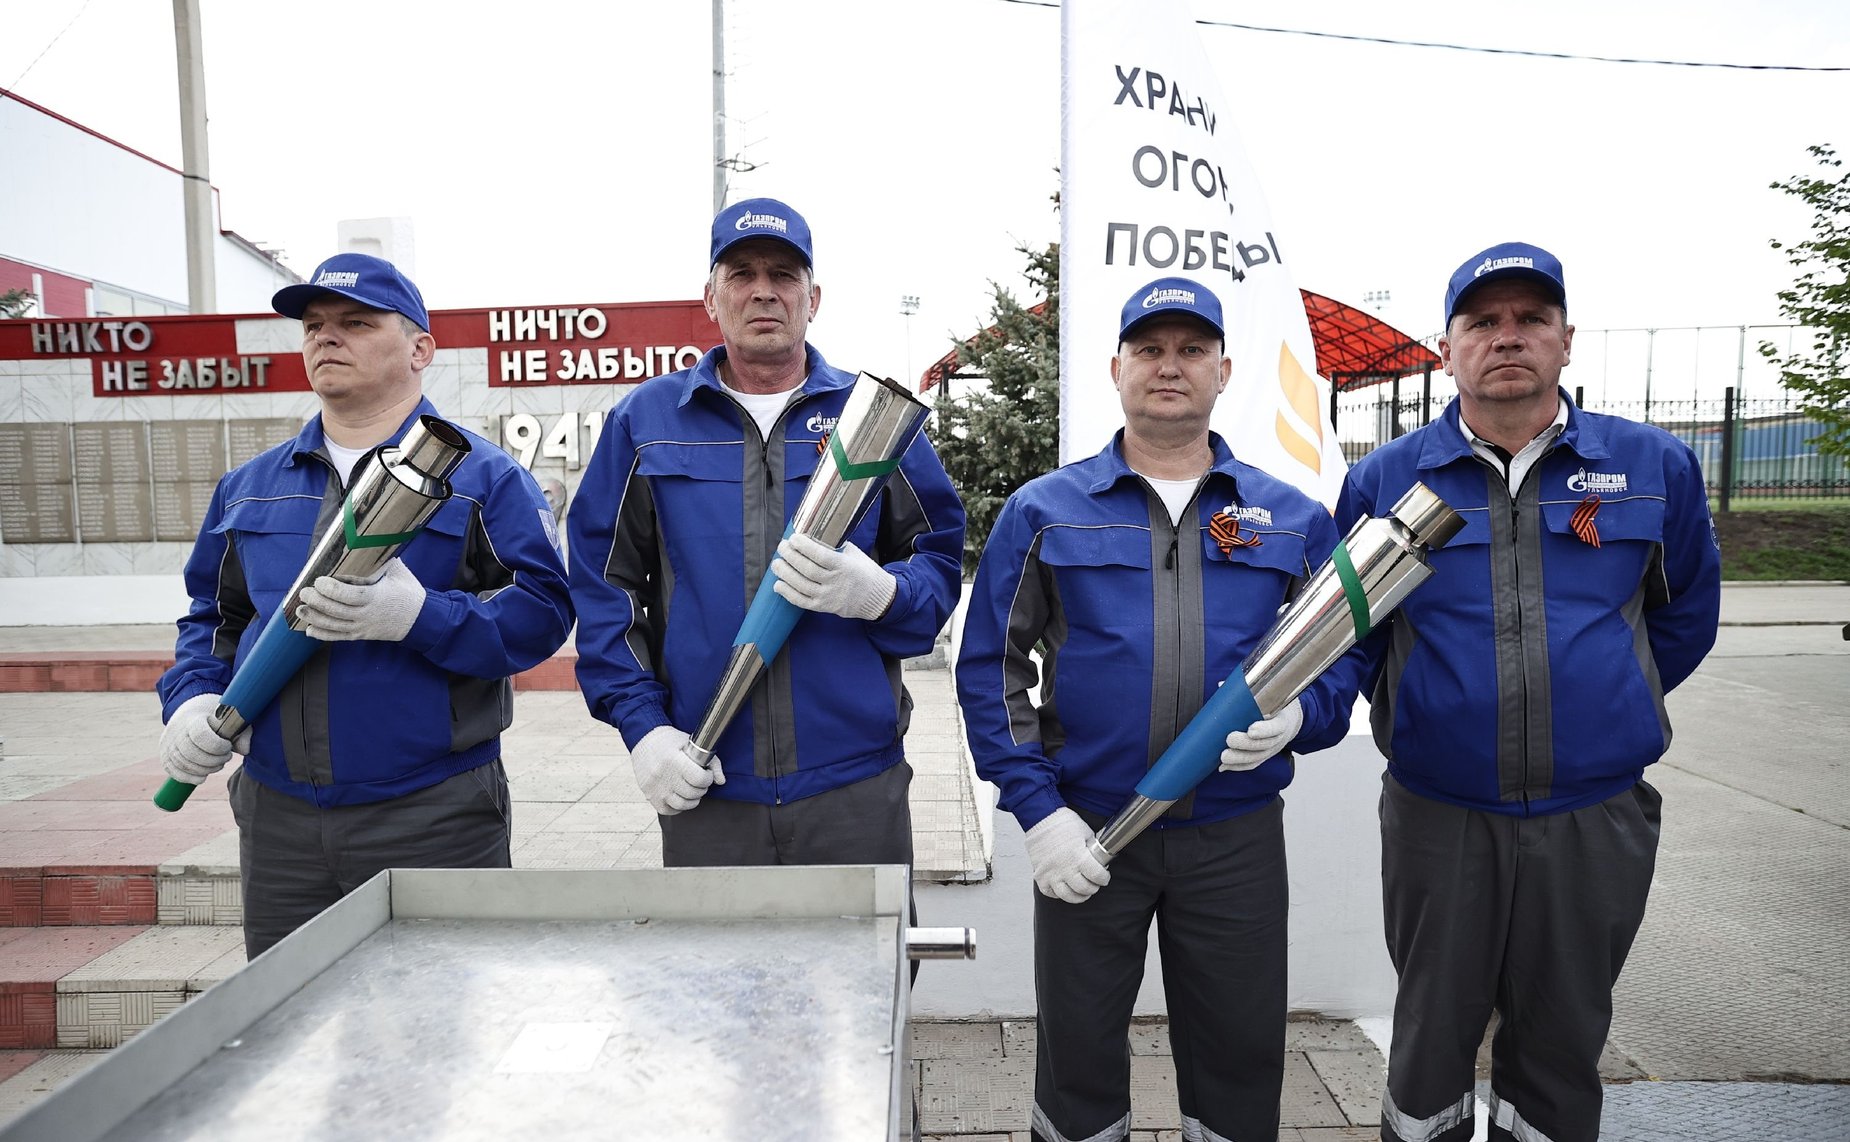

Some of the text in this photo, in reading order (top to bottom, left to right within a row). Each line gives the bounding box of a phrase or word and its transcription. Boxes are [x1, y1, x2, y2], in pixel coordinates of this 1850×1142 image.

[752, 214, 787, 227] ГАЗПРОМ
[1105, 221, 1282, 283] ПОБЕЫ
[1493, 256, 1533, 266] ГАЗПРОМ
[1159, 288, 1195, 299] ГАЗПРОМ
[489, 307, 607, 342] НИЧТО
[31, 321, 153, 353] НИКТО
[102, 356, 271, 391] НЕ ЗАБЫТ
[501, 345, 704, 382] НЕ ЗАБЫТО
[1587, 472, 1626, 483] ГАЗПРОМ
[1239, 506, 1272, 519] ГАЗПРОМ
